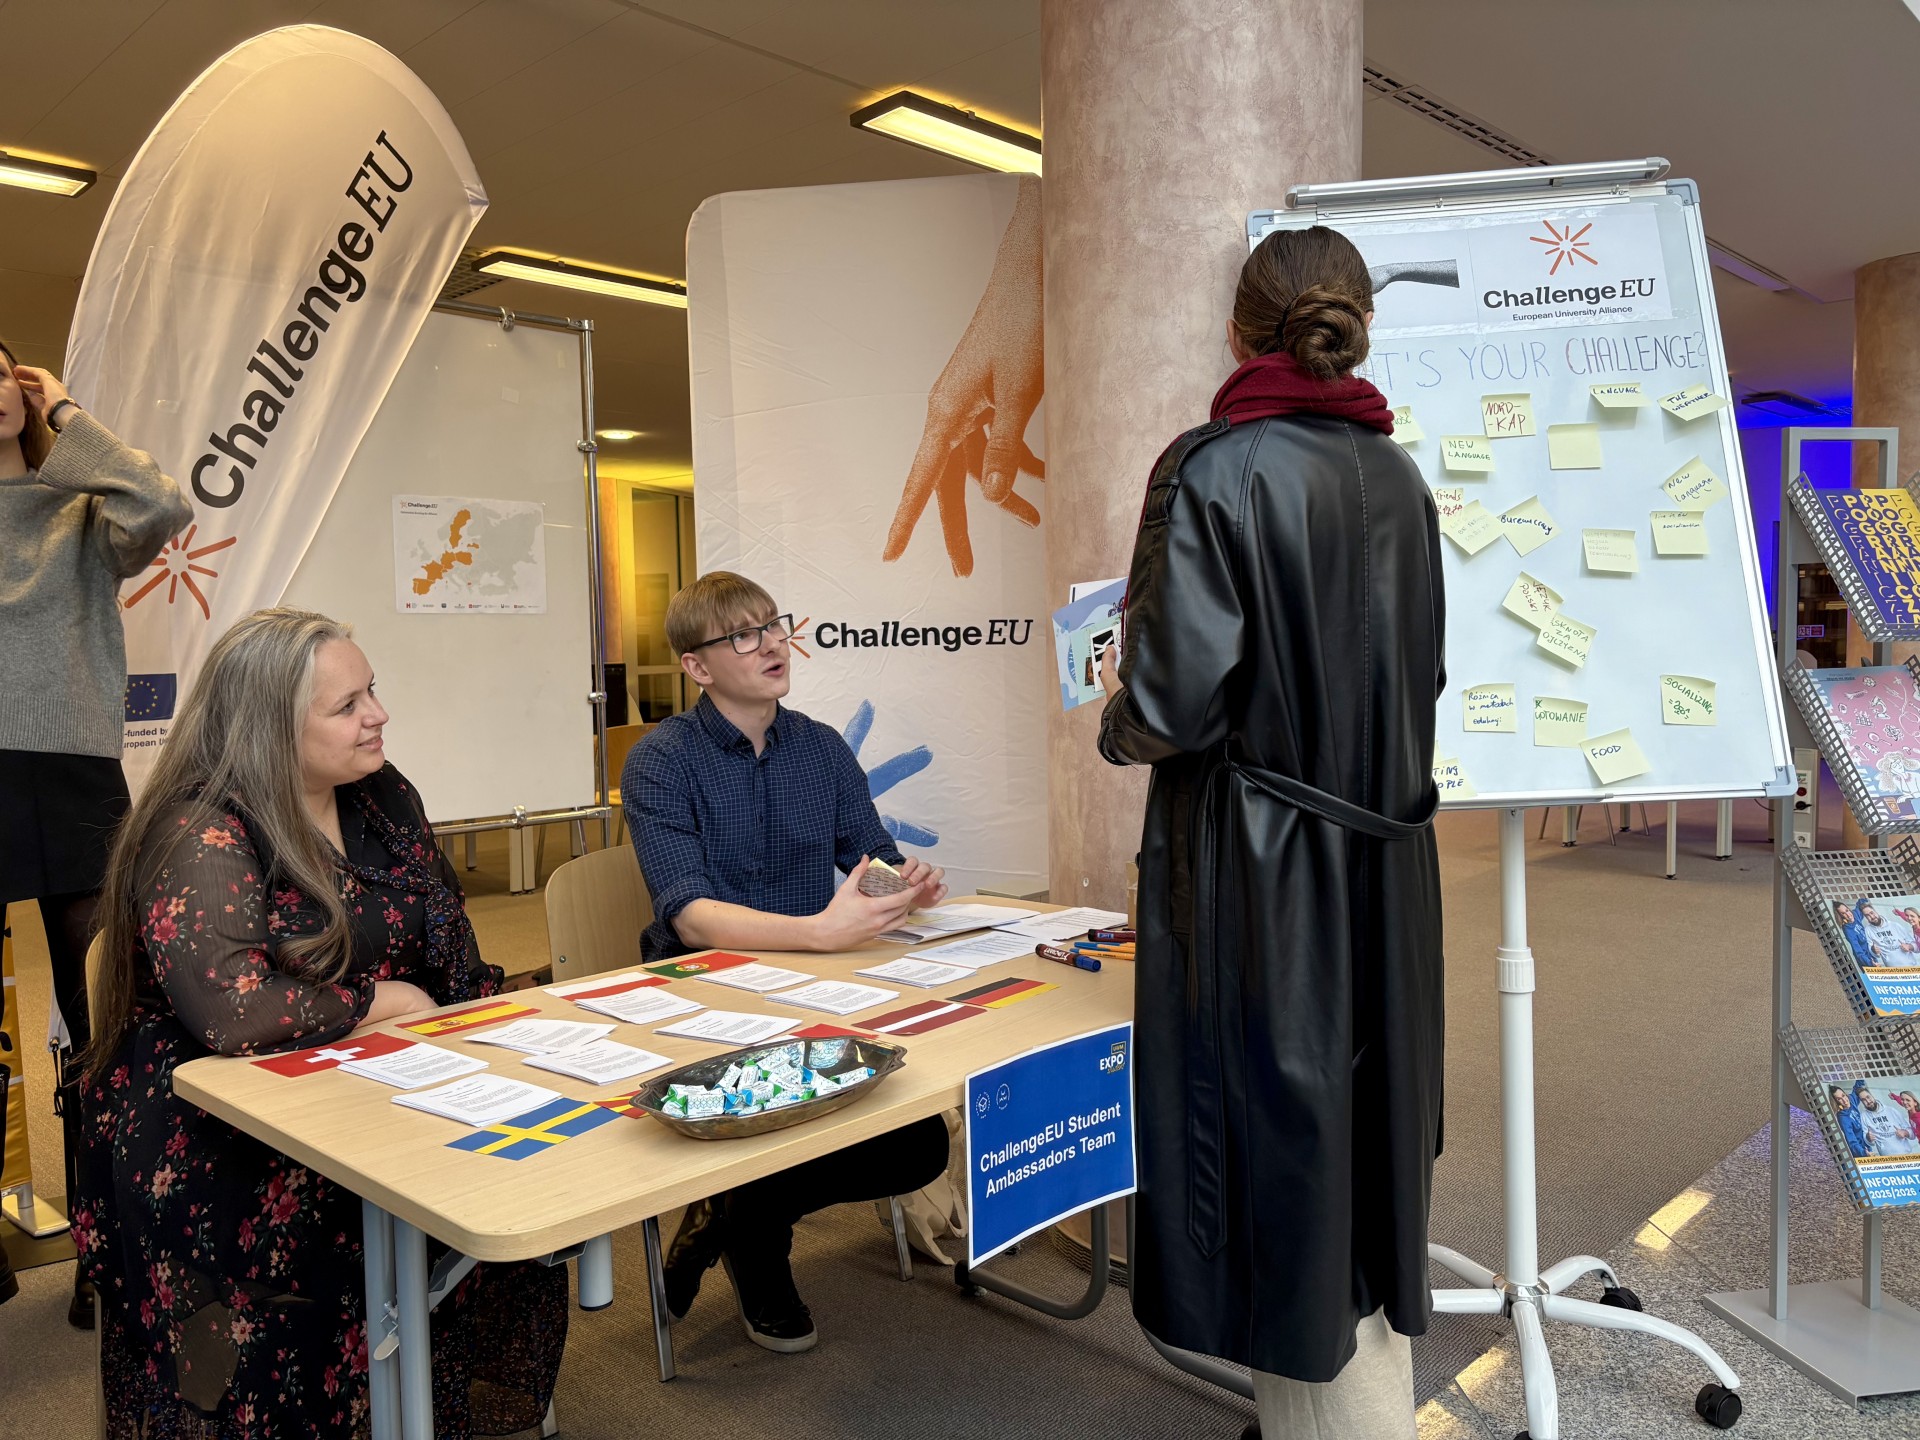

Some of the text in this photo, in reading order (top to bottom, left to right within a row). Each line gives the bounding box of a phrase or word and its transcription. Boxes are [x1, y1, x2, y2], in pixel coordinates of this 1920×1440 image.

[1513, 306, 1633, 321] European University Alliance
[1357, 350, 1442, 390] AT'S
[1459, 342, 1550, 380] YOUR
[1667, 391, 1687, 403] THE
[1448, 440, 1474, 449] NEW
[1448, 451, 1490, 461] LANGUAGE
[1556, 629, 1571, 641] ZA
[1591, 745, 1622, 759] FOOD
[1100, 1053, 1124, 1071] EXPO
[980, 1101, 1121, 1173] ChallengeEU Student
[986, 1129, 1116, 1198] Ambassadors Team
